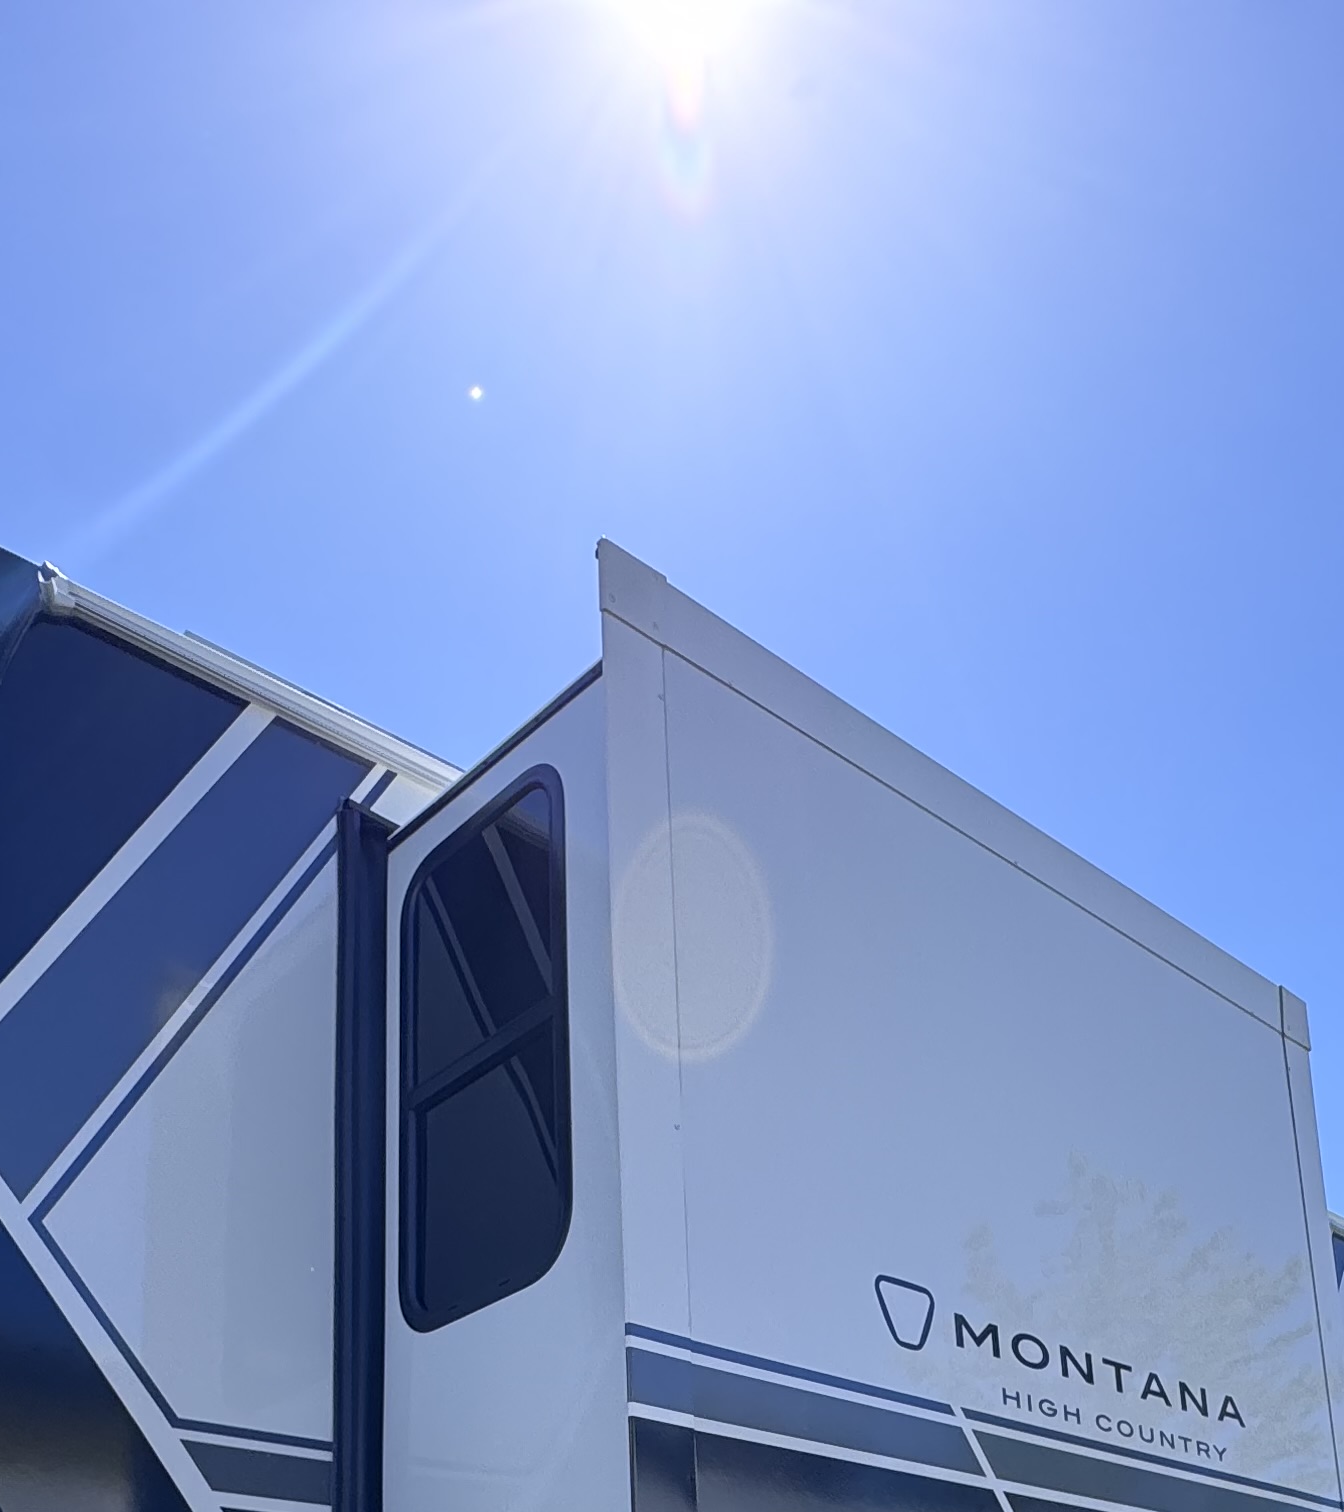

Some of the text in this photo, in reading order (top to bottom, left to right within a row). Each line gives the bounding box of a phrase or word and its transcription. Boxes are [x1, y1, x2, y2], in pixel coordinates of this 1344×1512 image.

[953, 1312, 1246, 1428] MONTANA
[1001, 1387, 1227, 1462] HIGH COUNTRY
